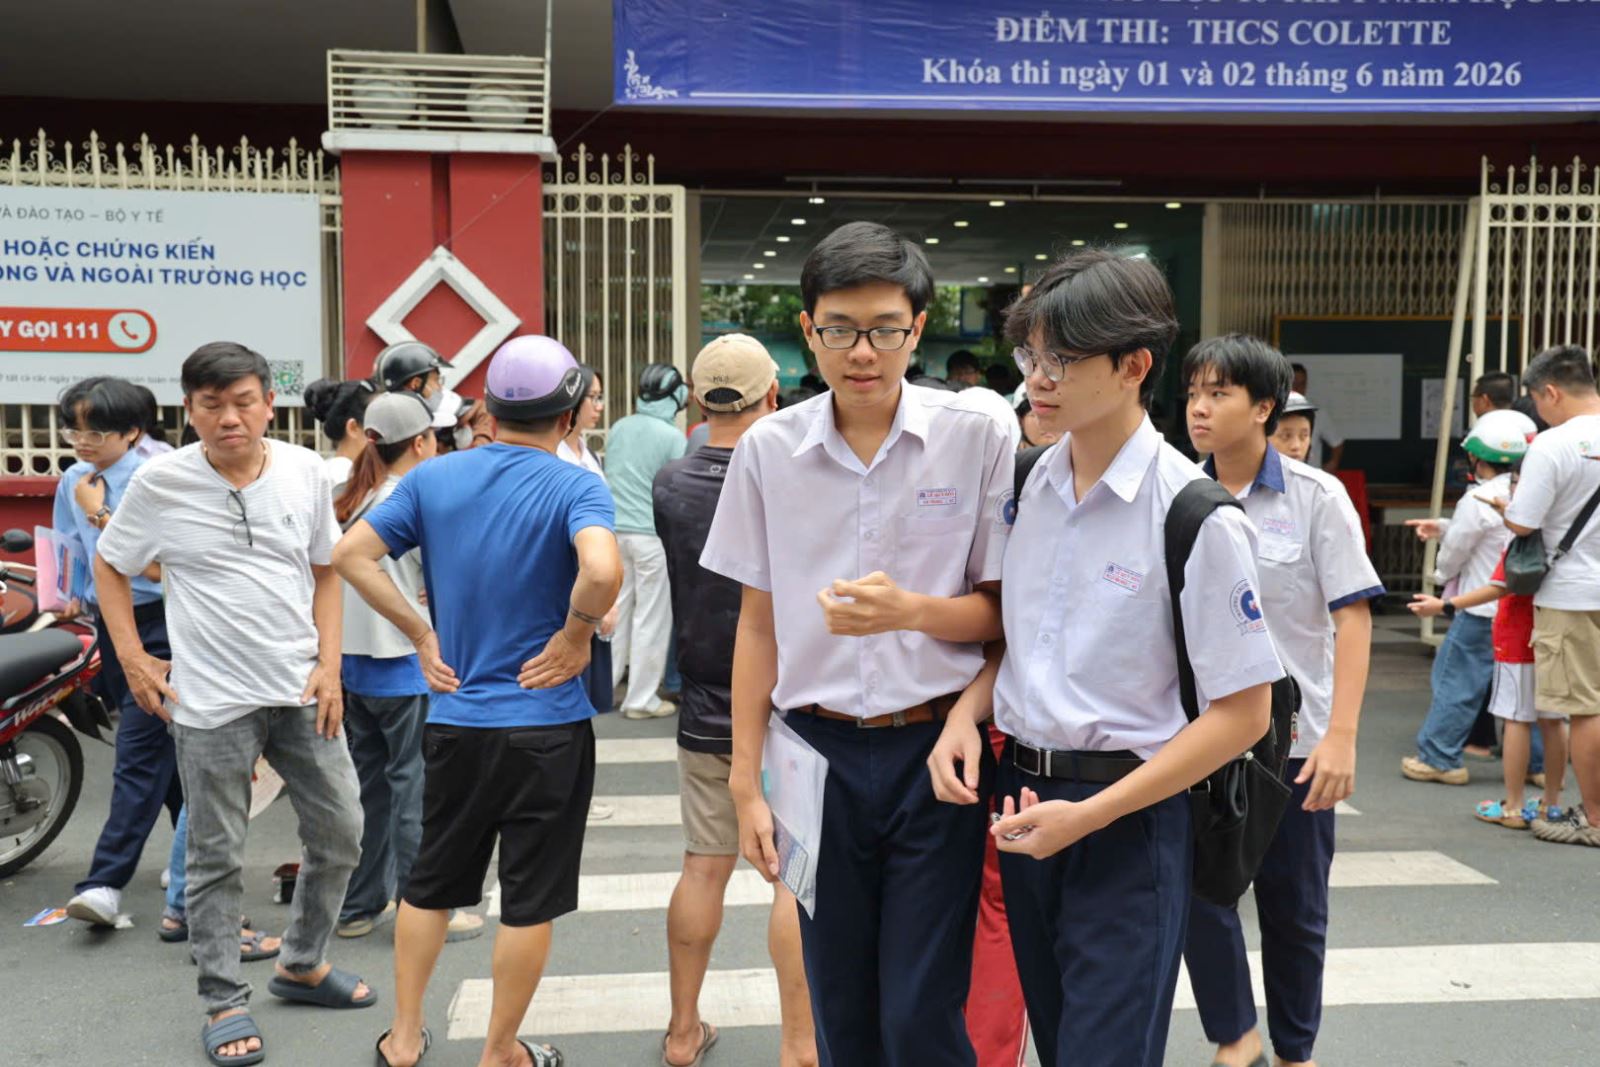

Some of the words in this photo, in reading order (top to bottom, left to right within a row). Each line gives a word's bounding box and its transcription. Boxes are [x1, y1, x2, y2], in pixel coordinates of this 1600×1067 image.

[995, 10, 1088, 43] ĐIỂM
[1097, 19, 1168, 43] THI:
[1188, 20, 1278, 44] THCS
[1289, 20, 1450, 45] COLETTE
[923, 59, 1001, 83] Khóa
[1011, 60, 1049, 84] thi
[1060, 61, 1128, 92] ngày
[1138, 61, 1168, 85] 01
[1181, 62, 1213, 85] và
[1223, 62, 1255, 86] 02
[1266, 62, 1347, 93] tháng
[1356, 63, 1372, 86] 6
[1383, 63, 1444, 86] năm
[1454, 62, 1521, 86] 2026
[17, 204, 50, 220] ĐÀO
[55, 207, 85, 223] TẠO
[105, 207, 126, 223] BỘ
[131, 211, 140, 221] Y
[146, 206, 164, 223] TẾ
[4, 238, 69, 260] HOẶC
[77, 237, 160, 259] CHỨNG
[165, 236, 215, 261] KIẾN
[45, 261, 75, 282] VÀ
[82, 265, 152, 283] NGOÀI
[160, 265, 254, 287] TRƯỜNG
[261, 271, 306, 290] HỌC
[18, 321, 57, 341] GỌI
[63, 322, 98, 338] 111
